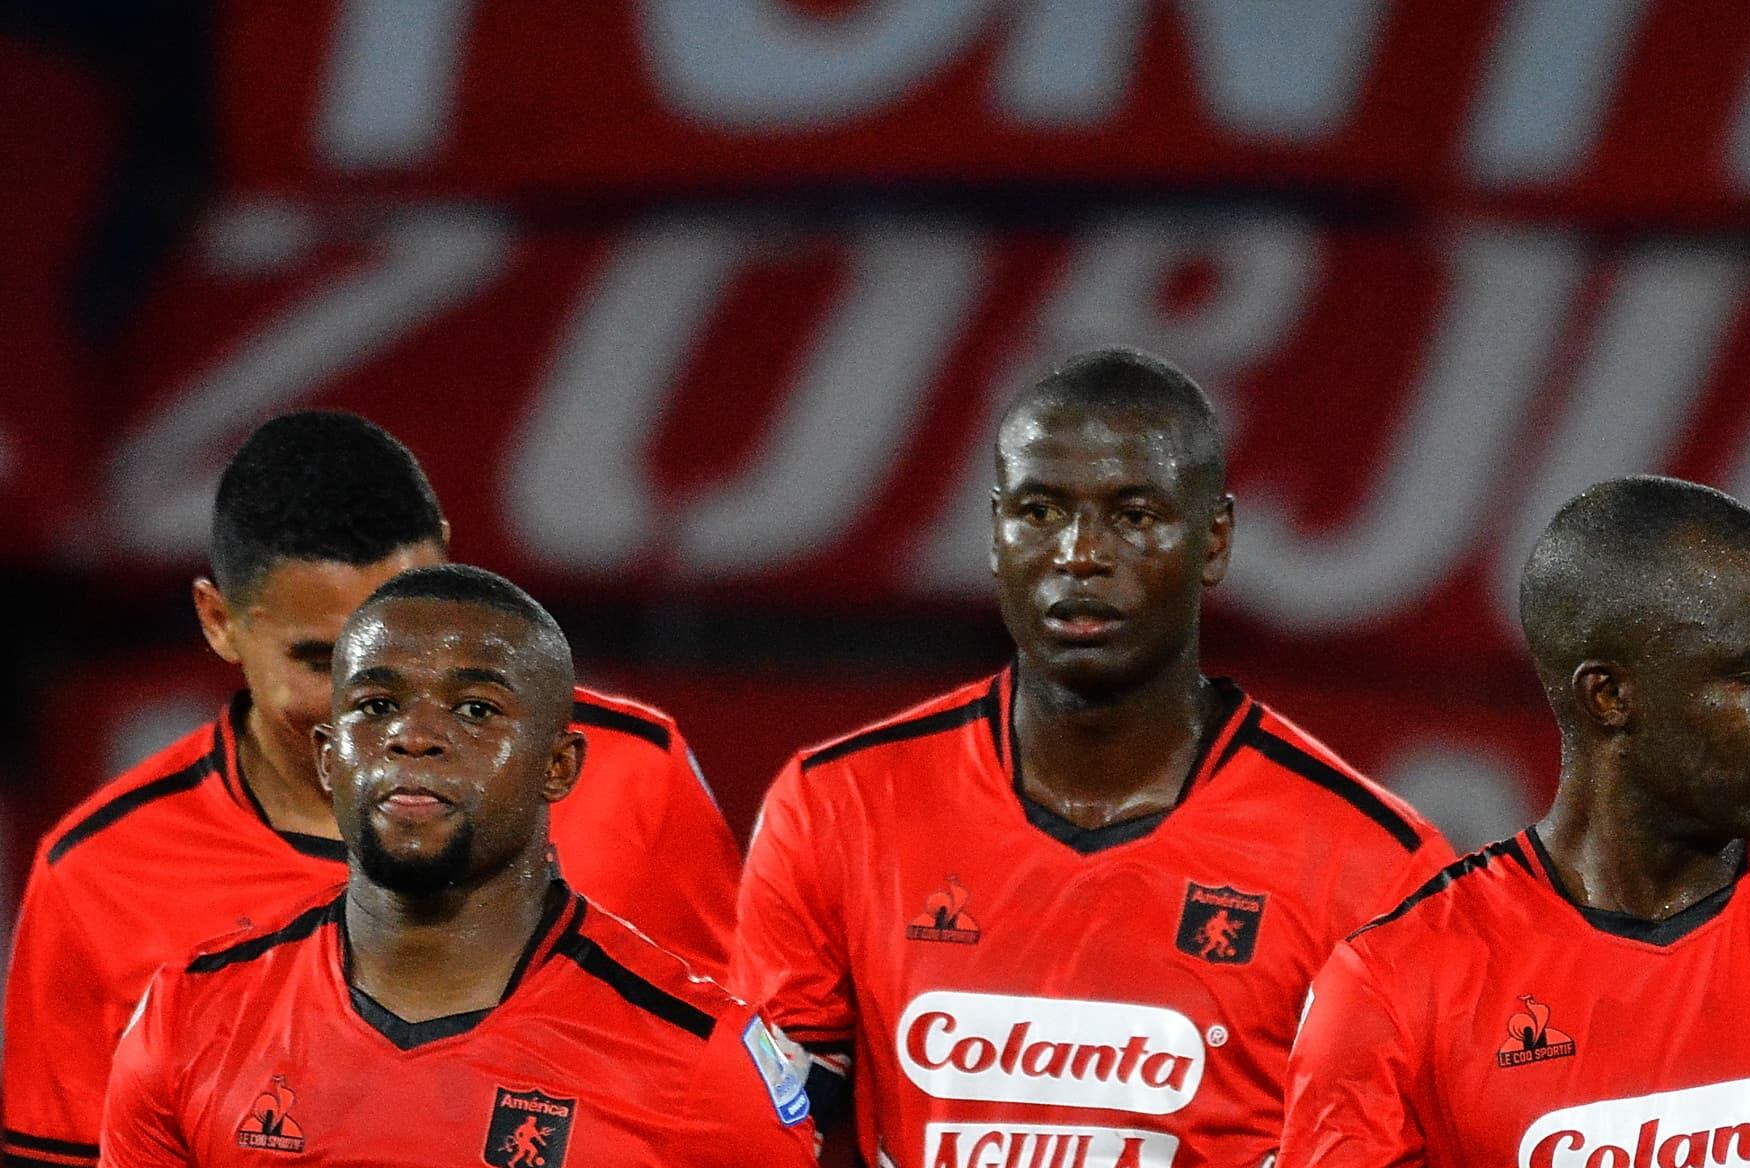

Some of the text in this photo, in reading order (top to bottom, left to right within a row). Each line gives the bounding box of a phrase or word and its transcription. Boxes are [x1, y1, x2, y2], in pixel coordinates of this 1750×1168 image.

[905, 1011, 1194, 1094] Colanta
[1535, 1042, 1574, 1060] SPORTIF
[501, 1093, 570, 1118] América
